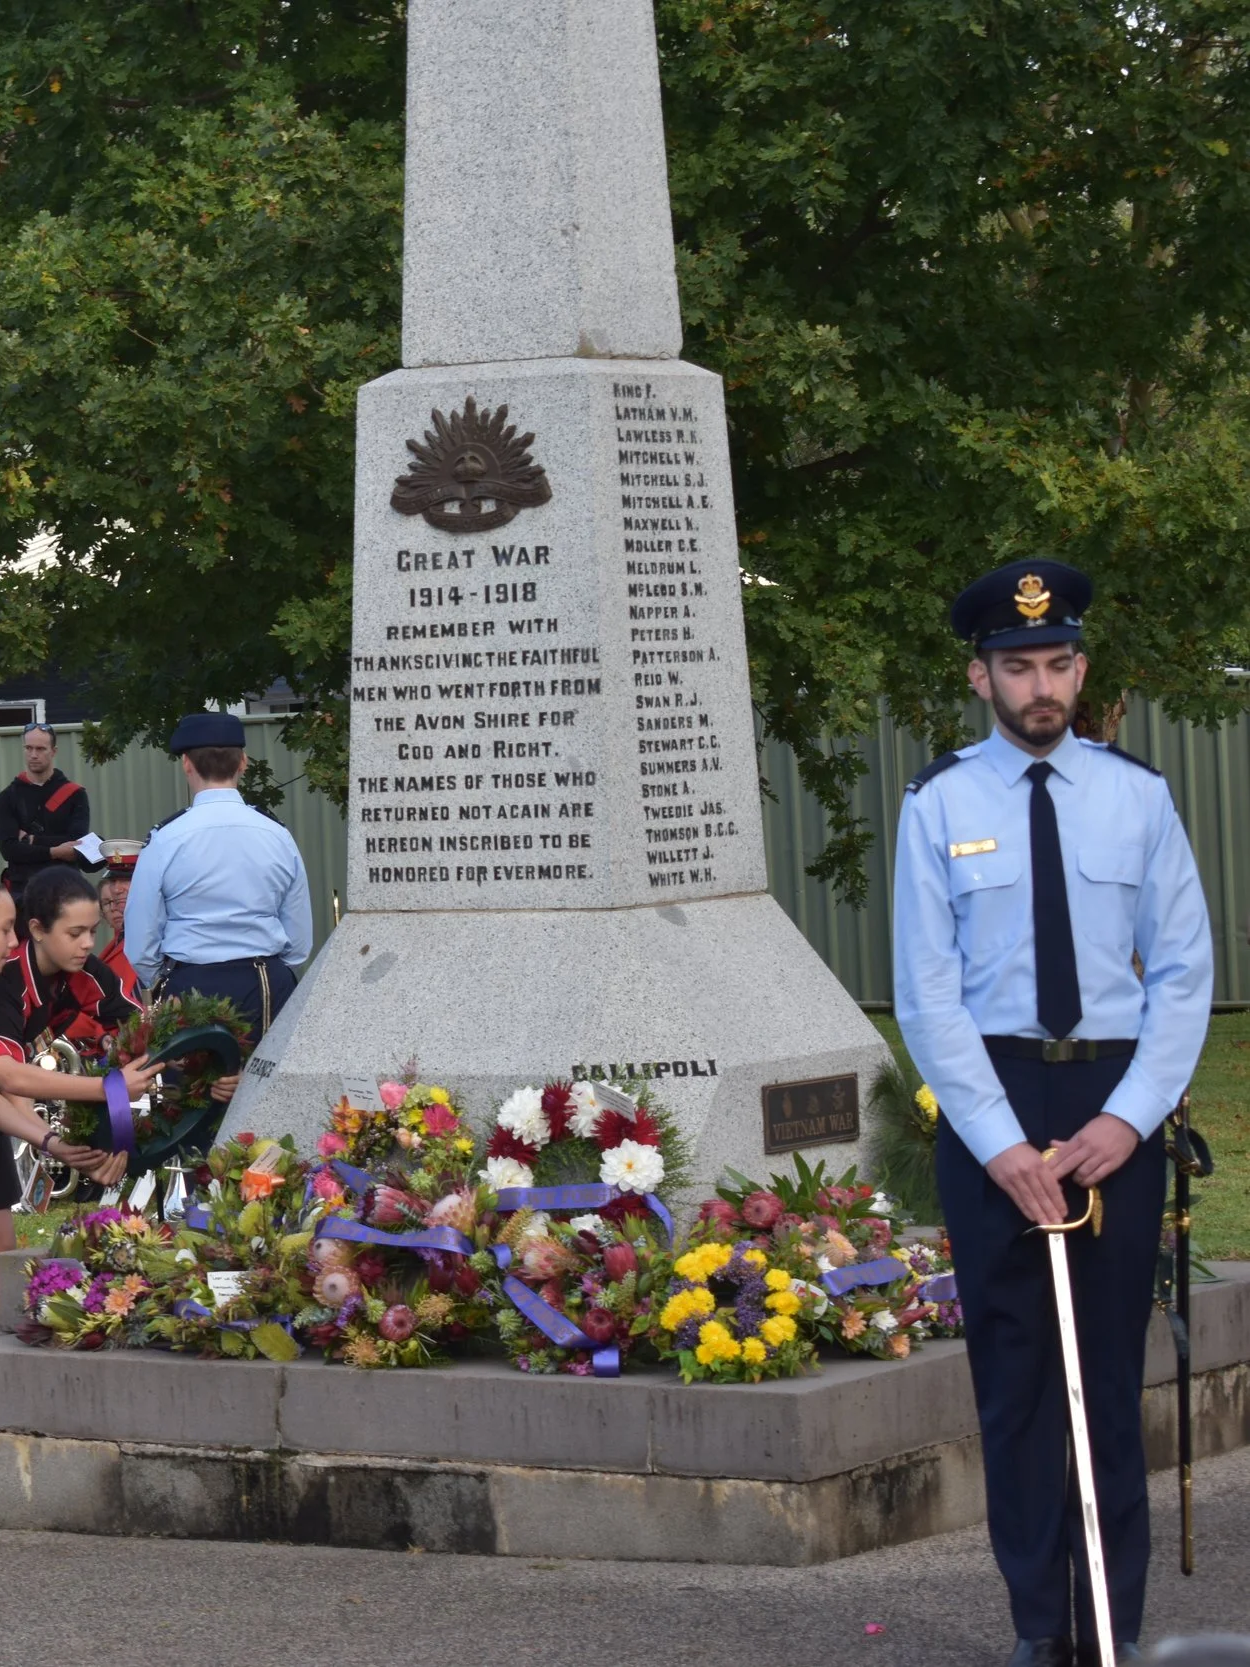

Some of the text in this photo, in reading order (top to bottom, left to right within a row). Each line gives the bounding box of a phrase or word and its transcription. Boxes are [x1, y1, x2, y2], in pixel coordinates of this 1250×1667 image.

[615, 404, 665, 420] LATHAM
[617, 428, 672, 443] LAWLESS
[619, 450, 681, 465] MITCHELL
[620, 472, 679, 486] MITCHELL
[622, 495, 683, 509] MITCHELL
[623, 517, 681, 531] MAXWELL
[625, 538, 672, 552] MOLLER
[397, 544, 551, 573] GREAT WAR
[627, 561, 685, 575] MELDRUM
[629, 605, 678, 620] NAPPER
[386, 618, 558, 640] REMEMBER WITH
[631, 628, 678, 642] PETERS
[354, 647, 600, 672] THANKSGIVING THE FAITHFUL
[633, 649, 703, 665] PATTERSON
[634, 673, 662, 687] REID
[353, 678, 600, 702] MEN WHO WENT FORTH FROM
[636, 694, 670, 709] SWAN
[375, 709, 576, 732] THE AVON SHIRE FOR
[637, 716, 693, 731] SANDERS
[398, 740, 559, 760] GOD AND RIGHT.
[639, 739, 694, 754] STEWART
[640, 760, 697, 776] SUMMERS
[358, 771, 596, 793] THE NAMES OF THOSE WHO
[642, 783, 678, 798] STONE
[361, 802, 594, 823] RETURNED NOT AGAIN ARE
[643, 804, 693, 820] TWEEDIE
[645, 826, 699, 843] THOMSON
[366, 833, 591, 854] HEREON INSCRIBED TO BE
[646, 847, 698, 865] WILLETT
[369, 863, 593, 883] HONORED FOR EVERMORE.
[648, 871, 685, 888] WHITE
[772, 1112, 855, 1141] VIETNAM WAR
